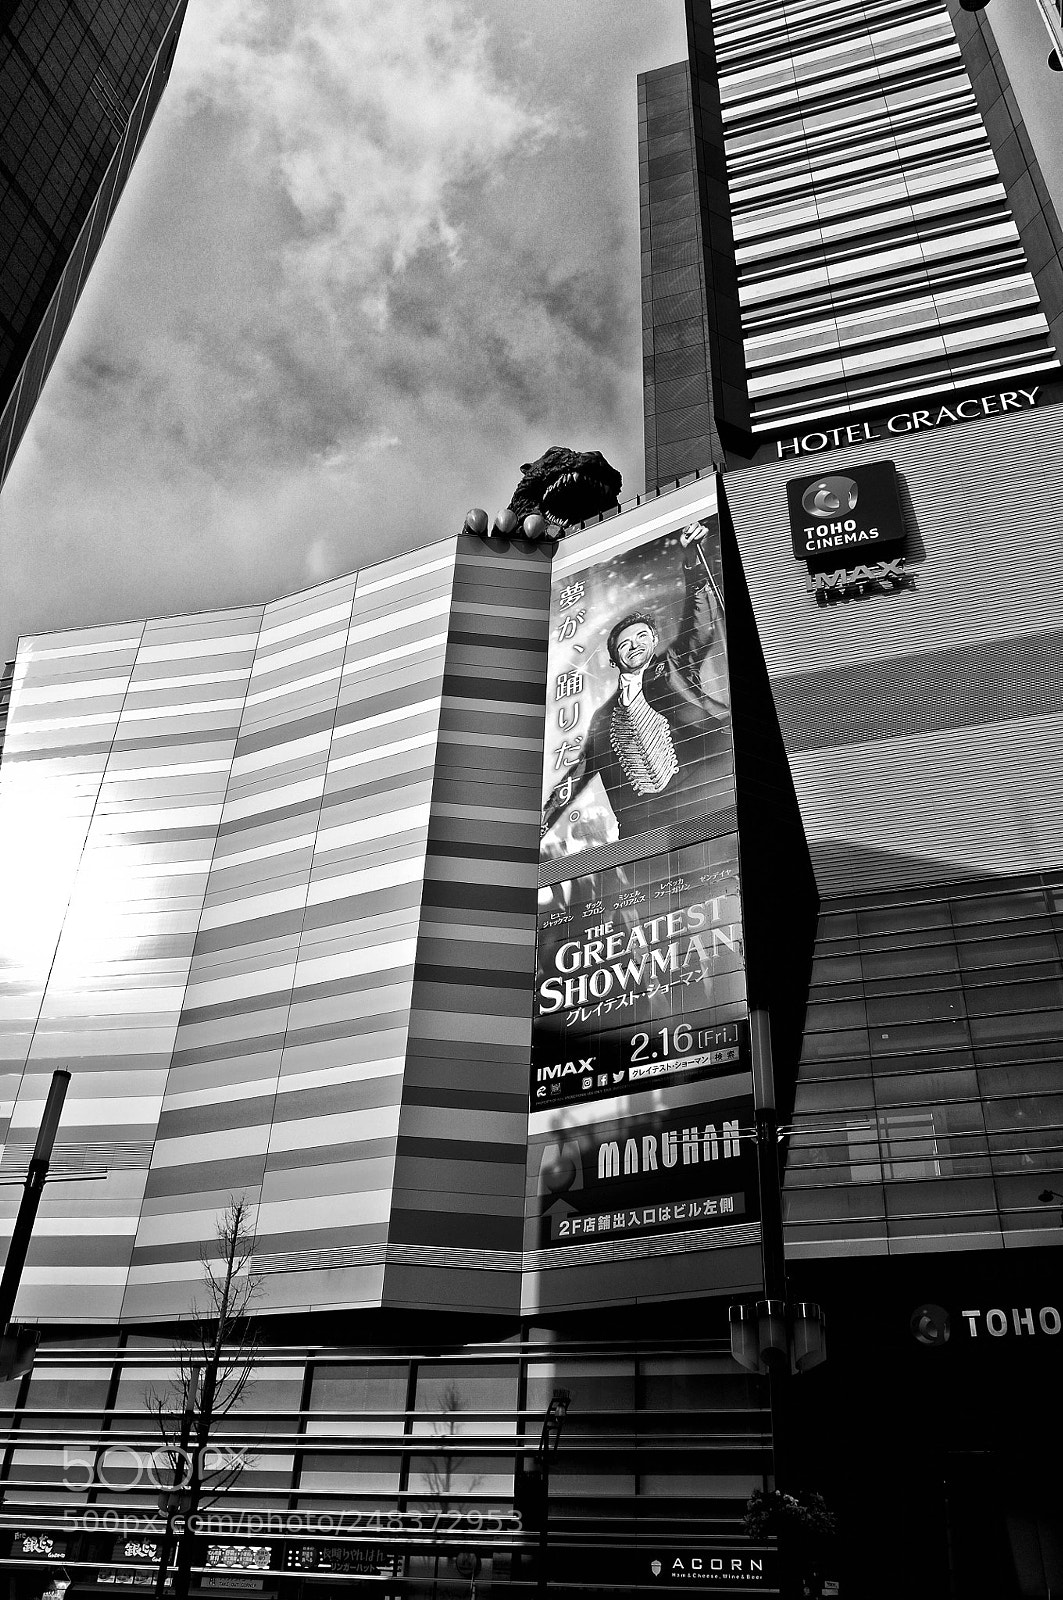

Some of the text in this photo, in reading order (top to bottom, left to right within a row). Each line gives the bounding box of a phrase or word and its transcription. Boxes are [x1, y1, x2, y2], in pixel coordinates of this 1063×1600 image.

[776, 386, 1040, 458] HOTEL GRACERY
[803, 519, 857, 540] TOHO
[804, 528, 880, 551] CINEMAS
[804, 558, 906, 592] IMAX
[554, 895, 729, 974] GREATEST
[584, 921, 615, 941] THE
[538, 923, 738, 1016] SHOWMAN
[566, 966, 710, 1027] グレイテスト・ショーマン
[630, 1023, 694, 1062] 2.16
[537, 1058, 595, 1082] IMAX
[598, 1119, 741, 1179] MARUHAN
[558, 1196, 735, 1237] 2F店舗出入口はビル左側
[961, 1306, 1062, 1338] TOHO
[672, 1557, 763, 1571] ACORN
